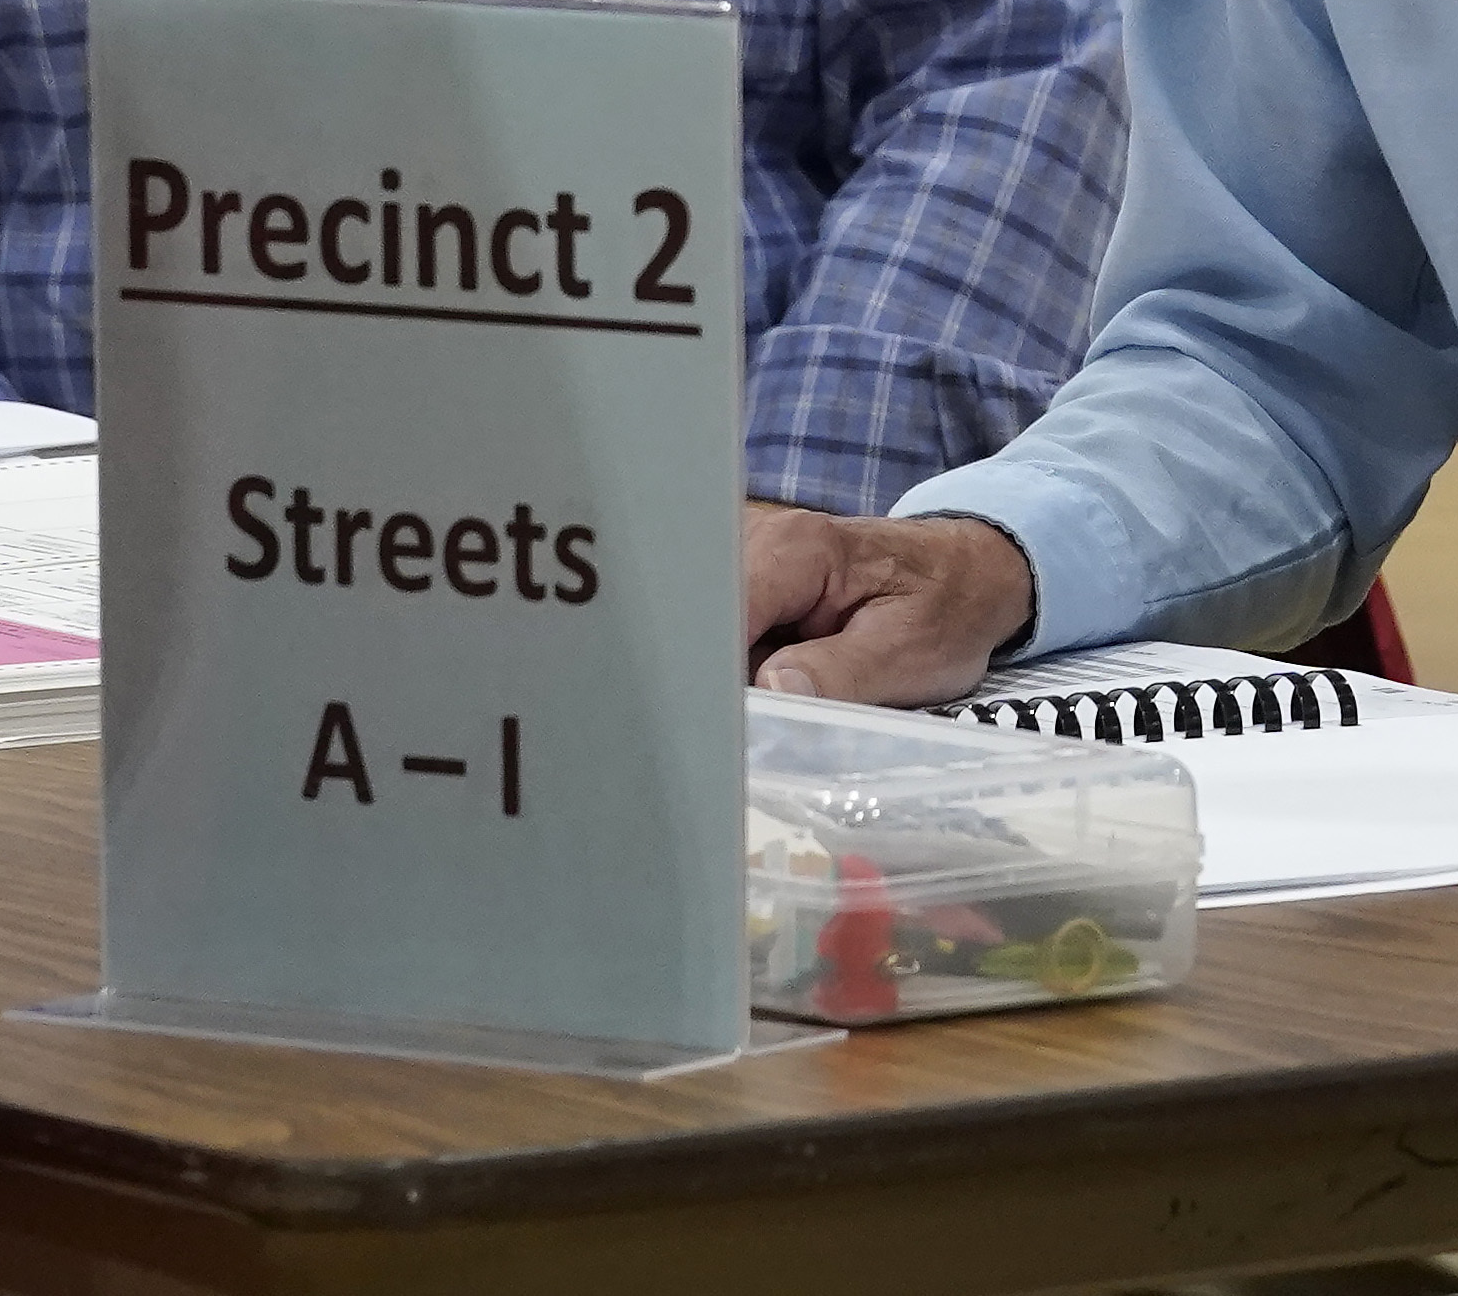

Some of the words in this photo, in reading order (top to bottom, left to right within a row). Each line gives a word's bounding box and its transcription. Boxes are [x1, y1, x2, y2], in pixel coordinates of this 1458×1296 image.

[124, 155, 593, 302] Precinct
[632, 186, 697, 306] 2
[223, 473, 602, 608] Streets
[299, 699, 378, 808] A
[499, 713, 523, 819] I
